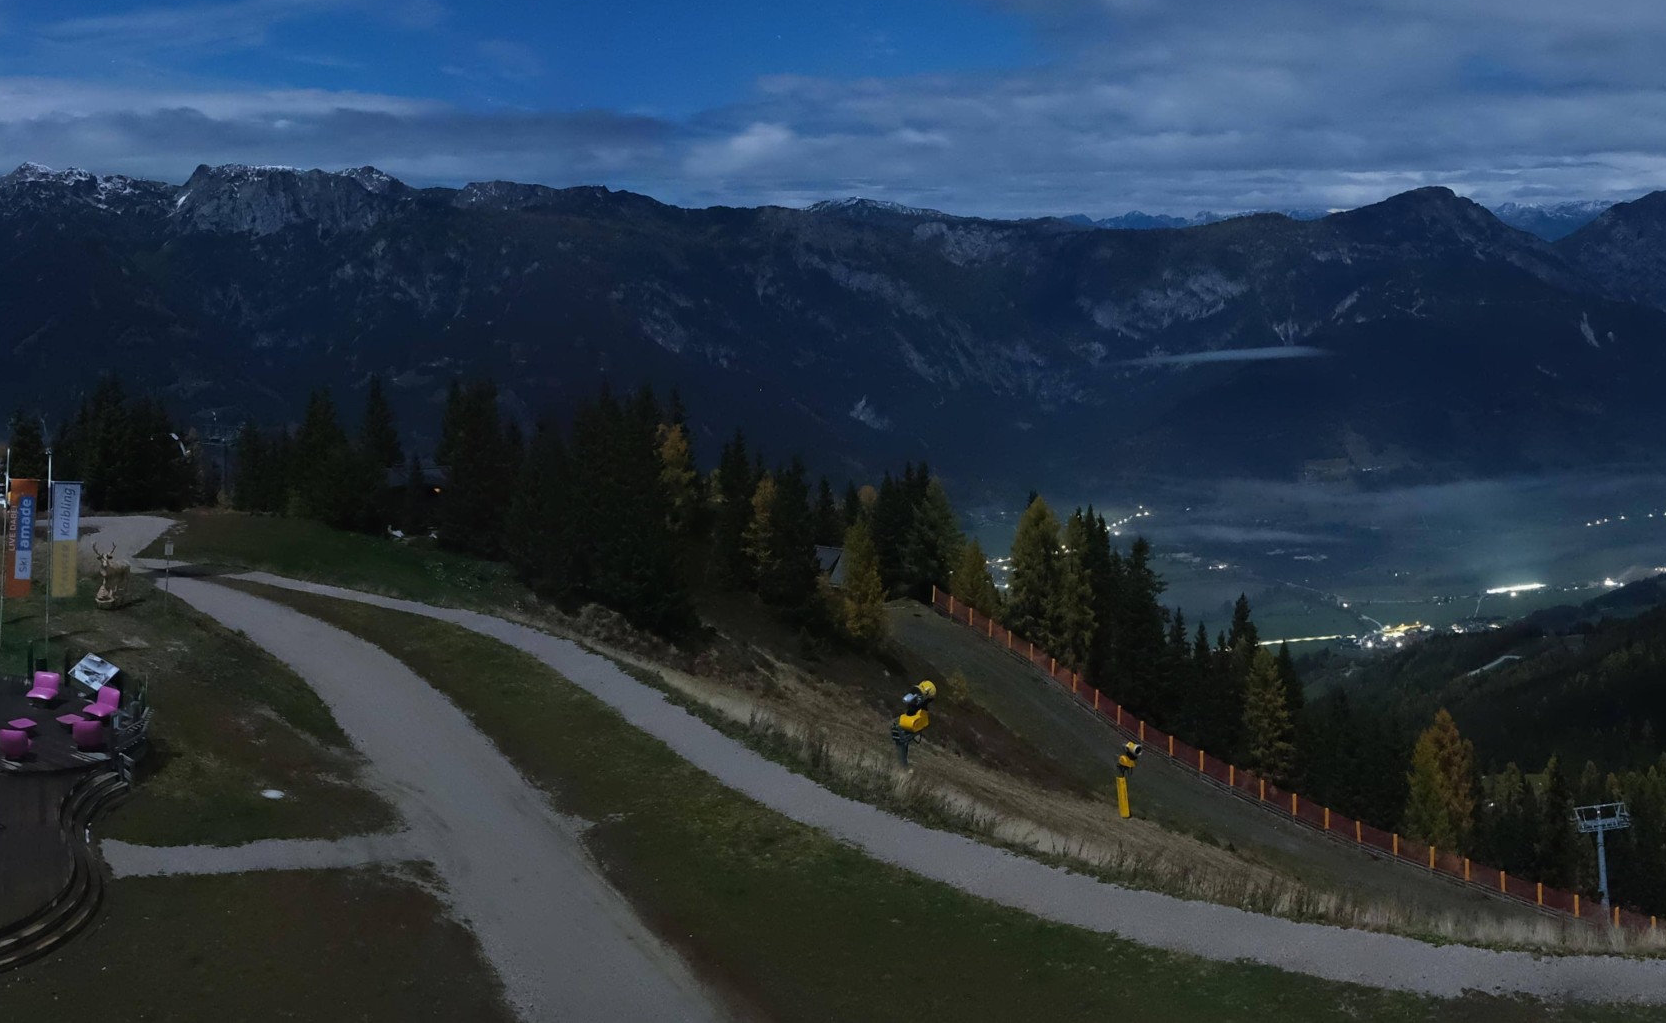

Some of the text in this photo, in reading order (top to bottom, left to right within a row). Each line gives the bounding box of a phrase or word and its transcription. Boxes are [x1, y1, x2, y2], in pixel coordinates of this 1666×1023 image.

[60, 487, 75, 536] Kaibling
[8, 533, 16, 552] LIVE
[18, 557, 28, 573] Ski
